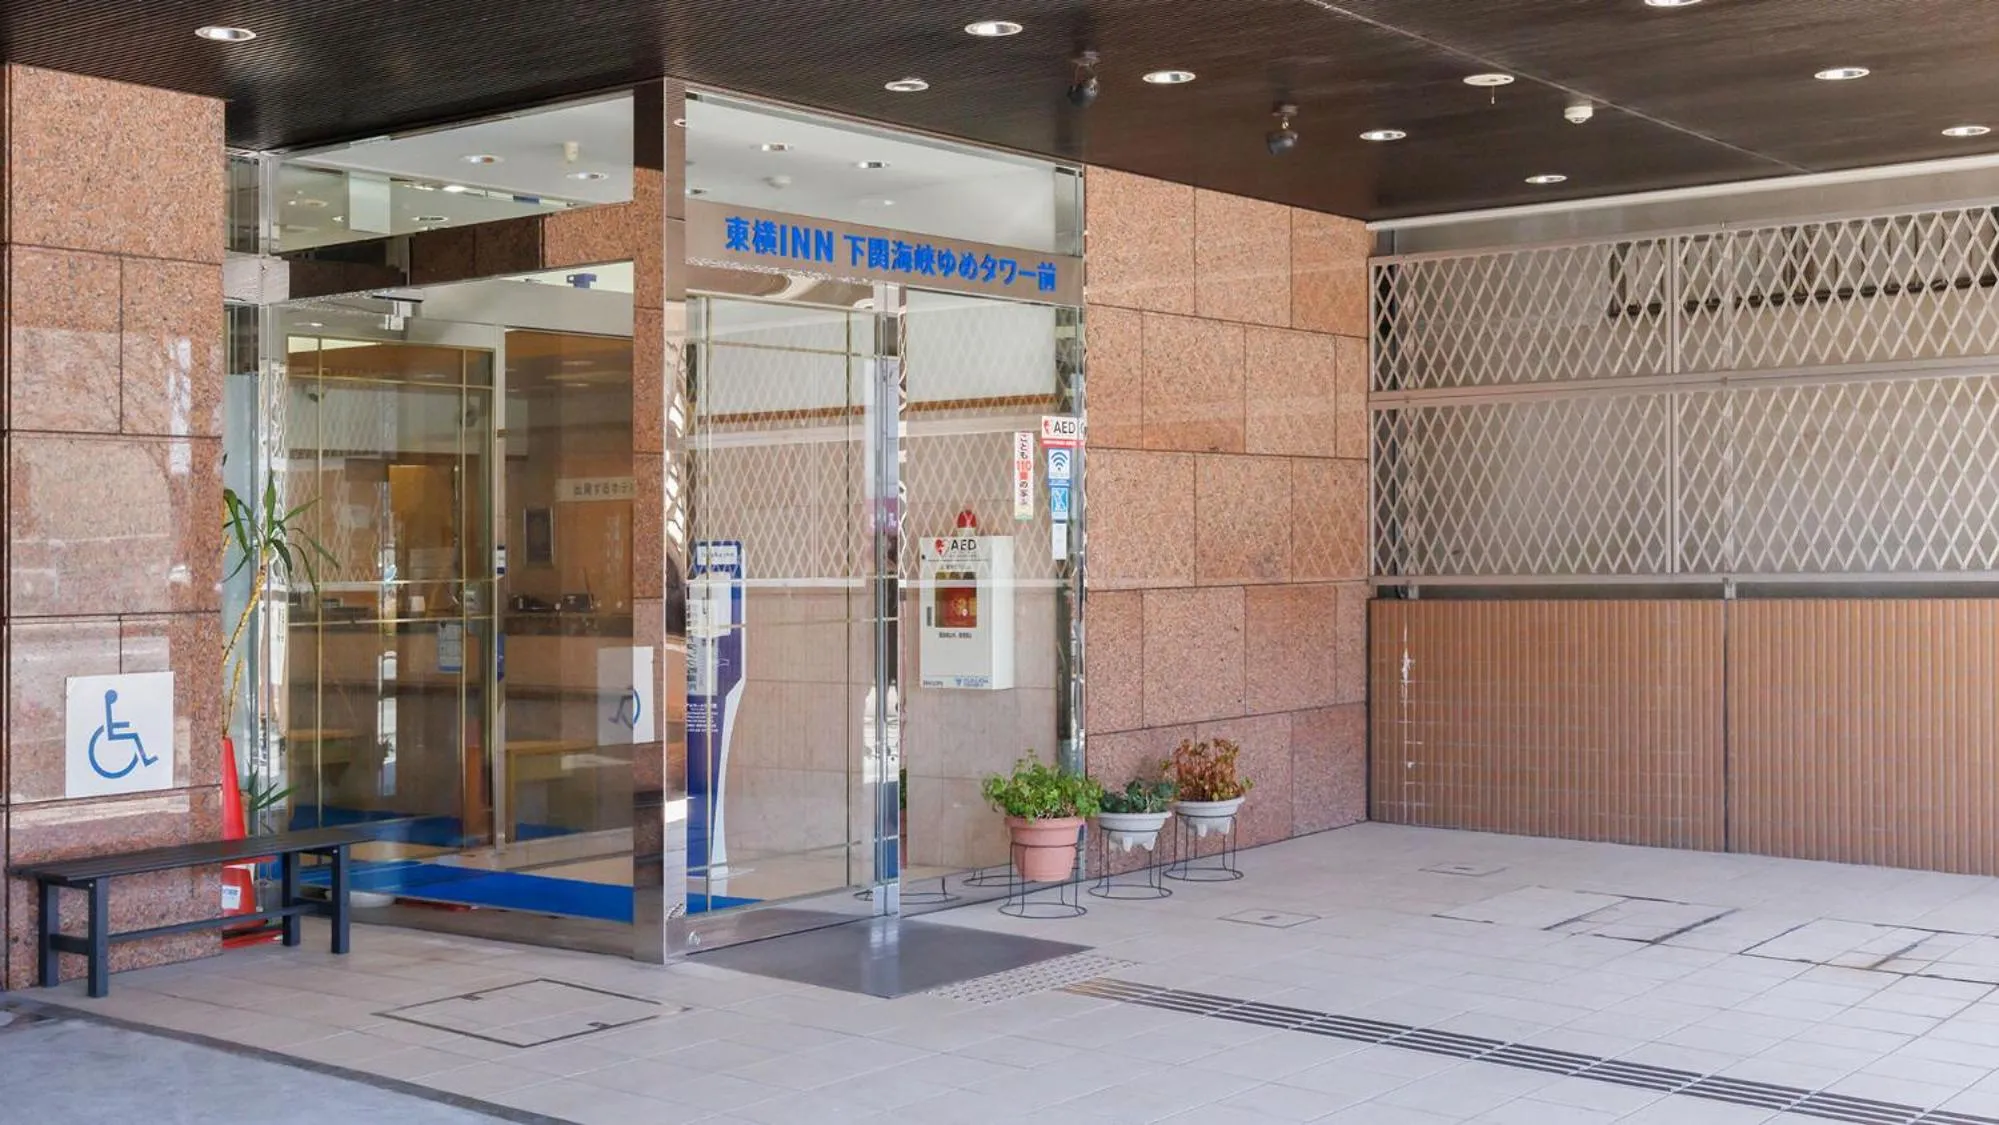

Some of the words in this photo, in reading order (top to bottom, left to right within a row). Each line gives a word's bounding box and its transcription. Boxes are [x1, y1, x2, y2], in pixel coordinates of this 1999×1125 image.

[725, 216, 834, 263] 東横INN
[843, 234, 1057, 293] 下関海峡ゆめタワー前
[1053, 420, 1076, 435] AED
[950, 539, 977, 551] AED
